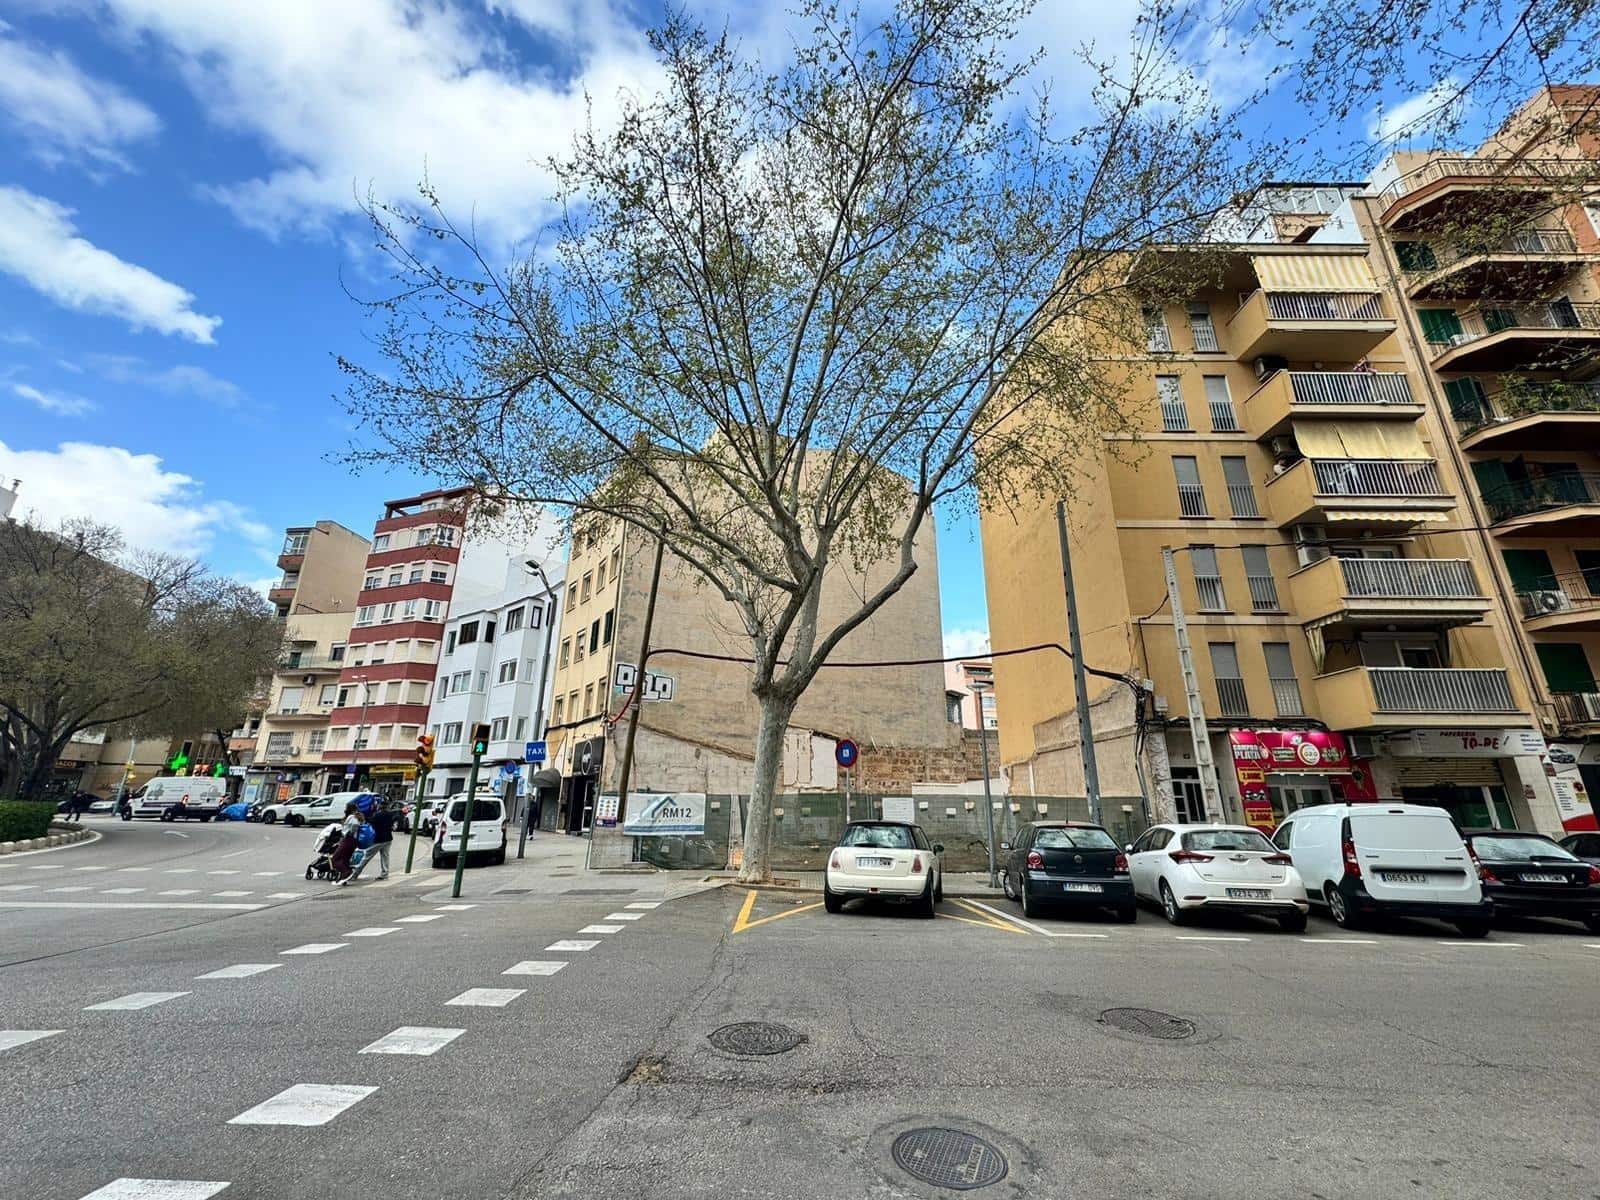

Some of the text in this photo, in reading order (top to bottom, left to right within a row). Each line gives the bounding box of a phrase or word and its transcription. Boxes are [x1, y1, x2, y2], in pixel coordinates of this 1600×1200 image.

[1462, 737, 1499, 750] TO-PE
[662, 807, 692, 818] RM12
[1386, 873, 1408, 882] 0653
